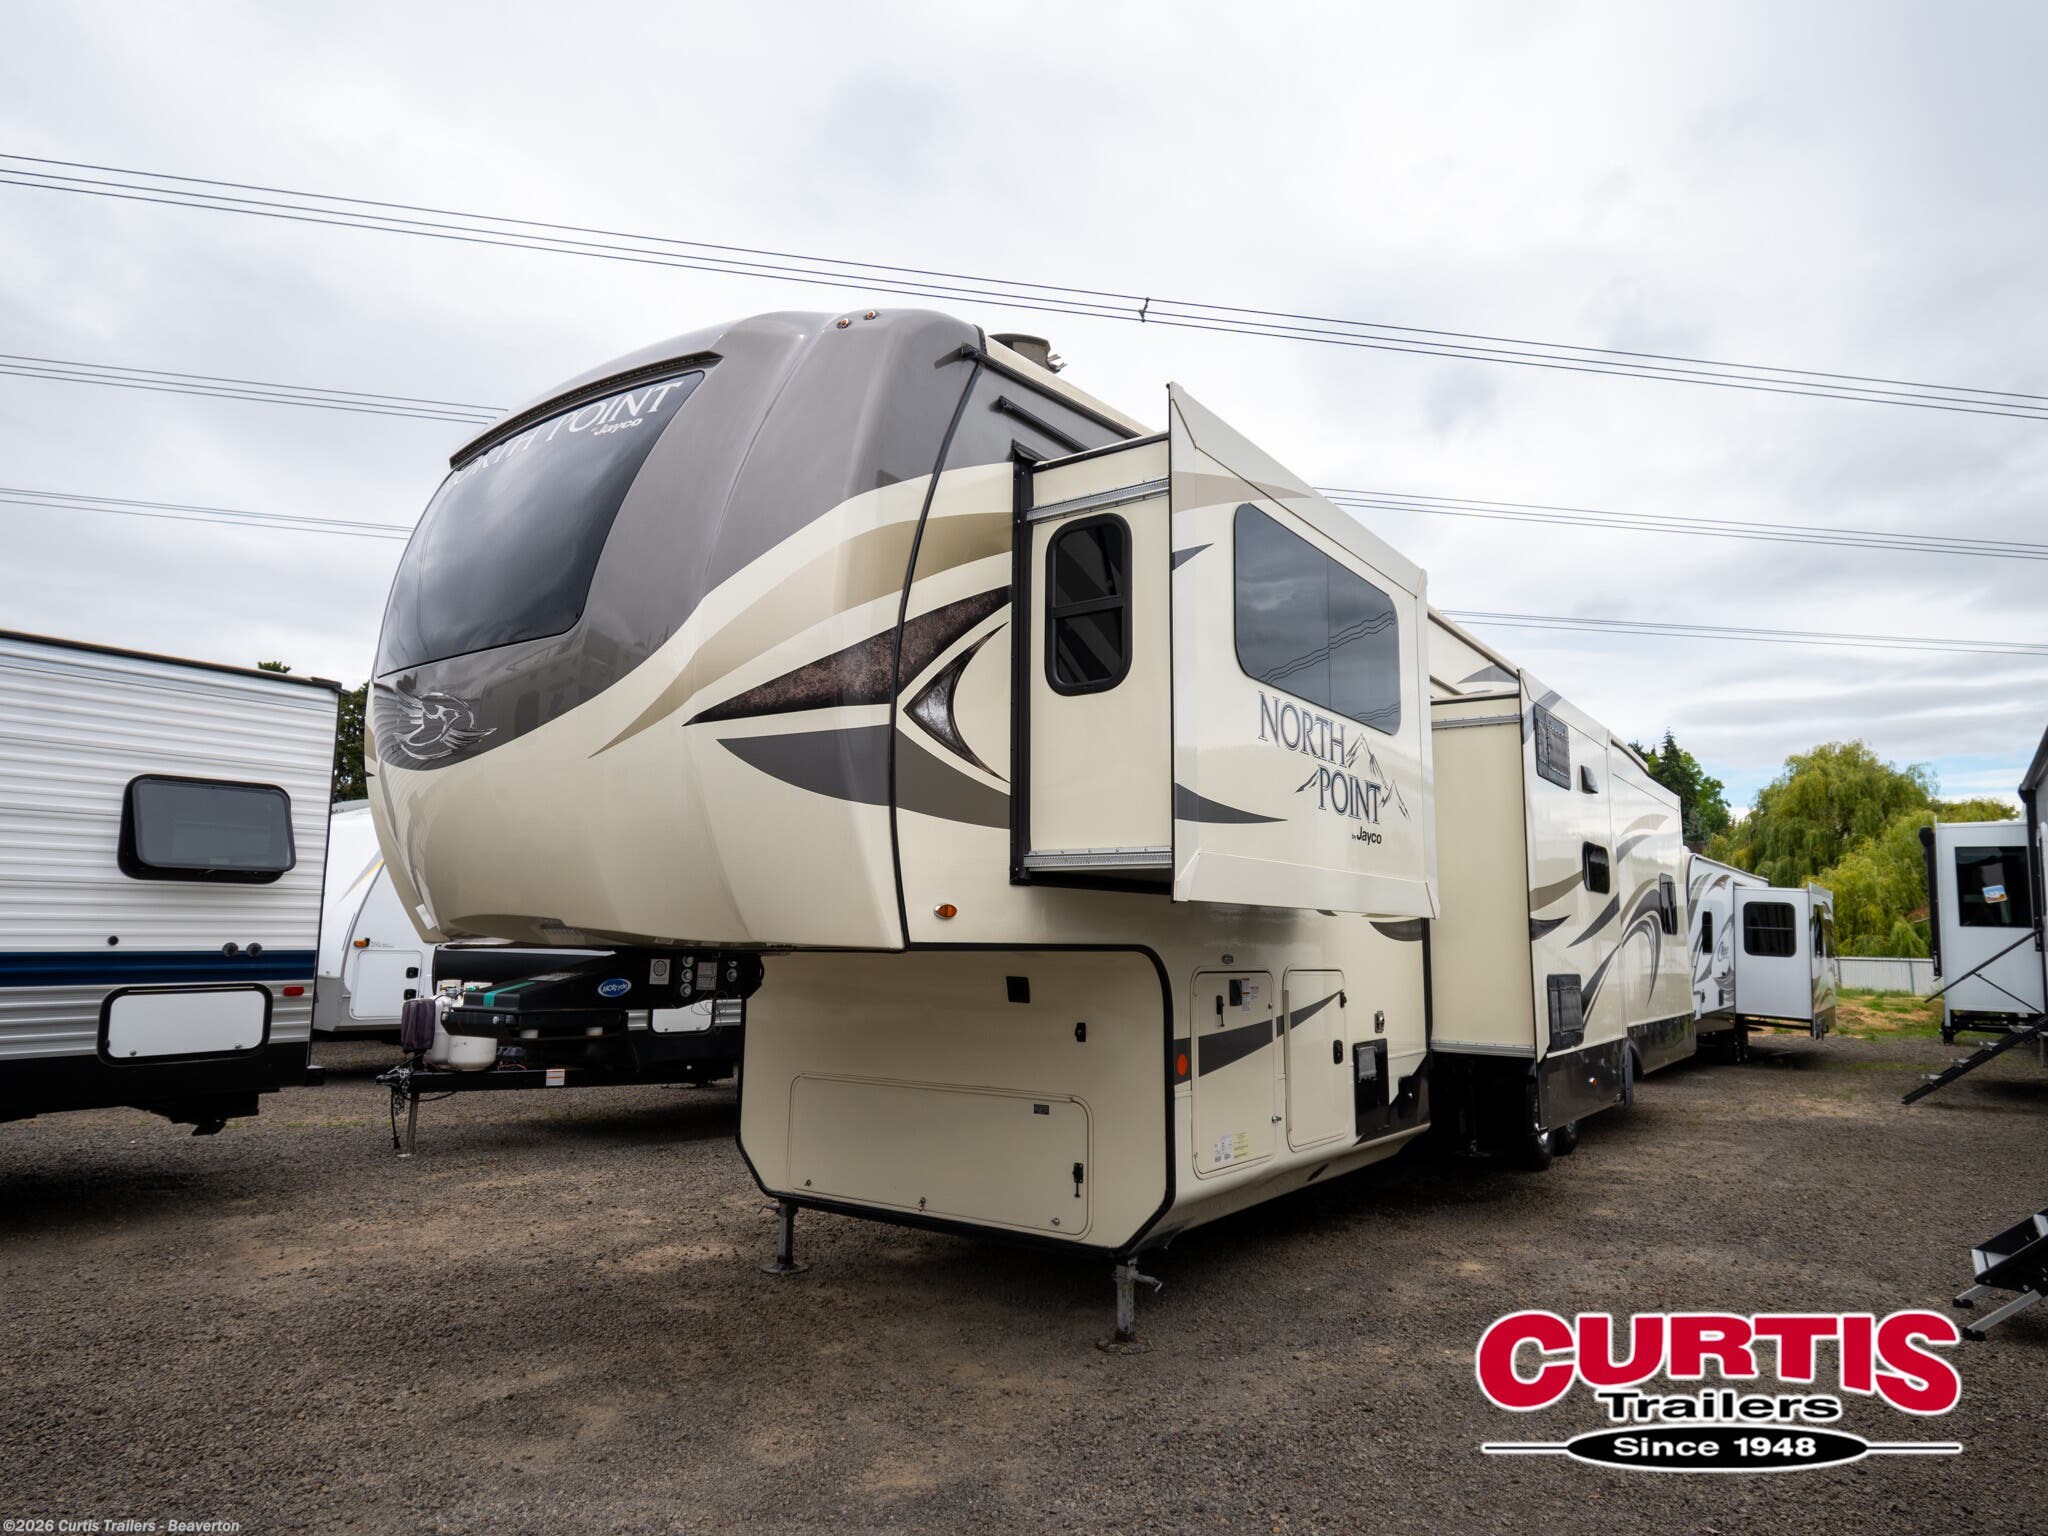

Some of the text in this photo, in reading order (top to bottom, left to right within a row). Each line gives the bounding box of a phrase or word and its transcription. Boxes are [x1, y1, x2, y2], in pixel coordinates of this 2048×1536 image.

[593, 418, 643, 435] Jayco
[1258, 690, 1347, 768] NORTH
[1317, 763, 1381, 824] POINT
[1356, 825, 1382, 846] Jayco
